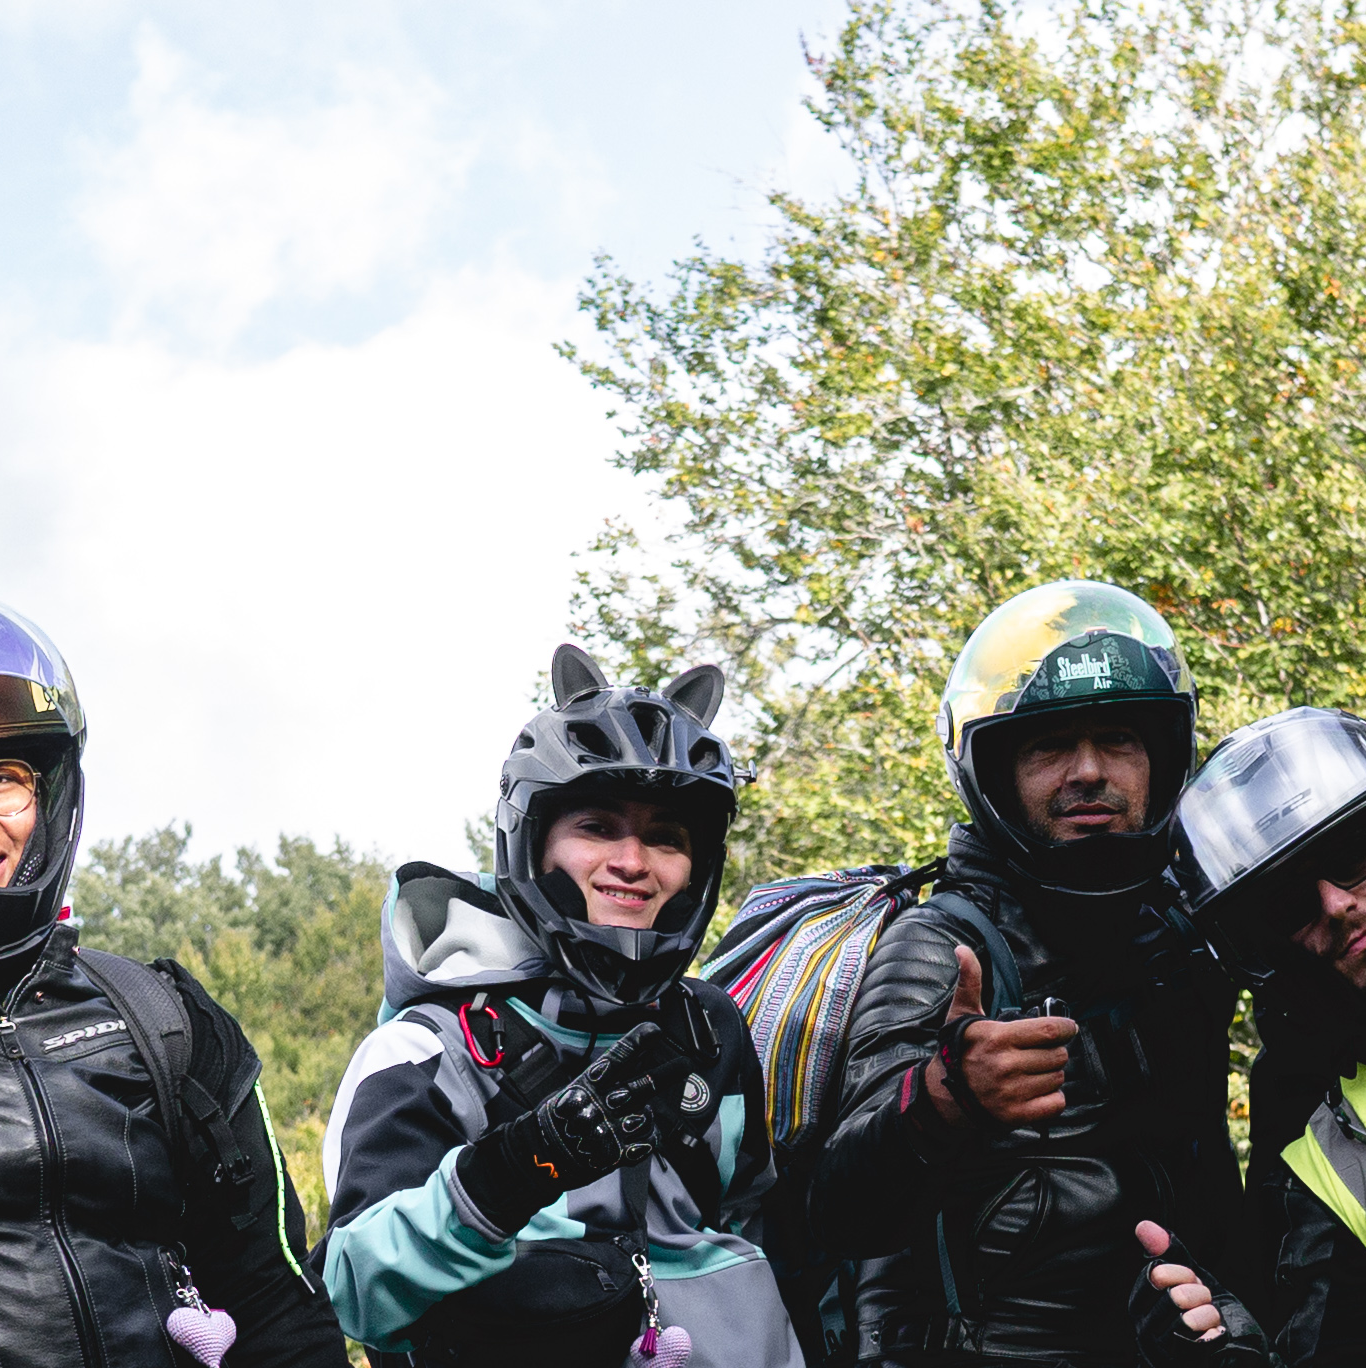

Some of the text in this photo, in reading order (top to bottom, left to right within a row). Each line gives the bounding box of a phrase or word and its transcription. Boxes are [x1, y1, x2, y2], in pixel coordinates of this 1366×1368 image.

[1056, 652, 1112, 682] Steelbird
[1093, 677, 1113, 690] Air
[1252, 787, 1313, 834] S2
